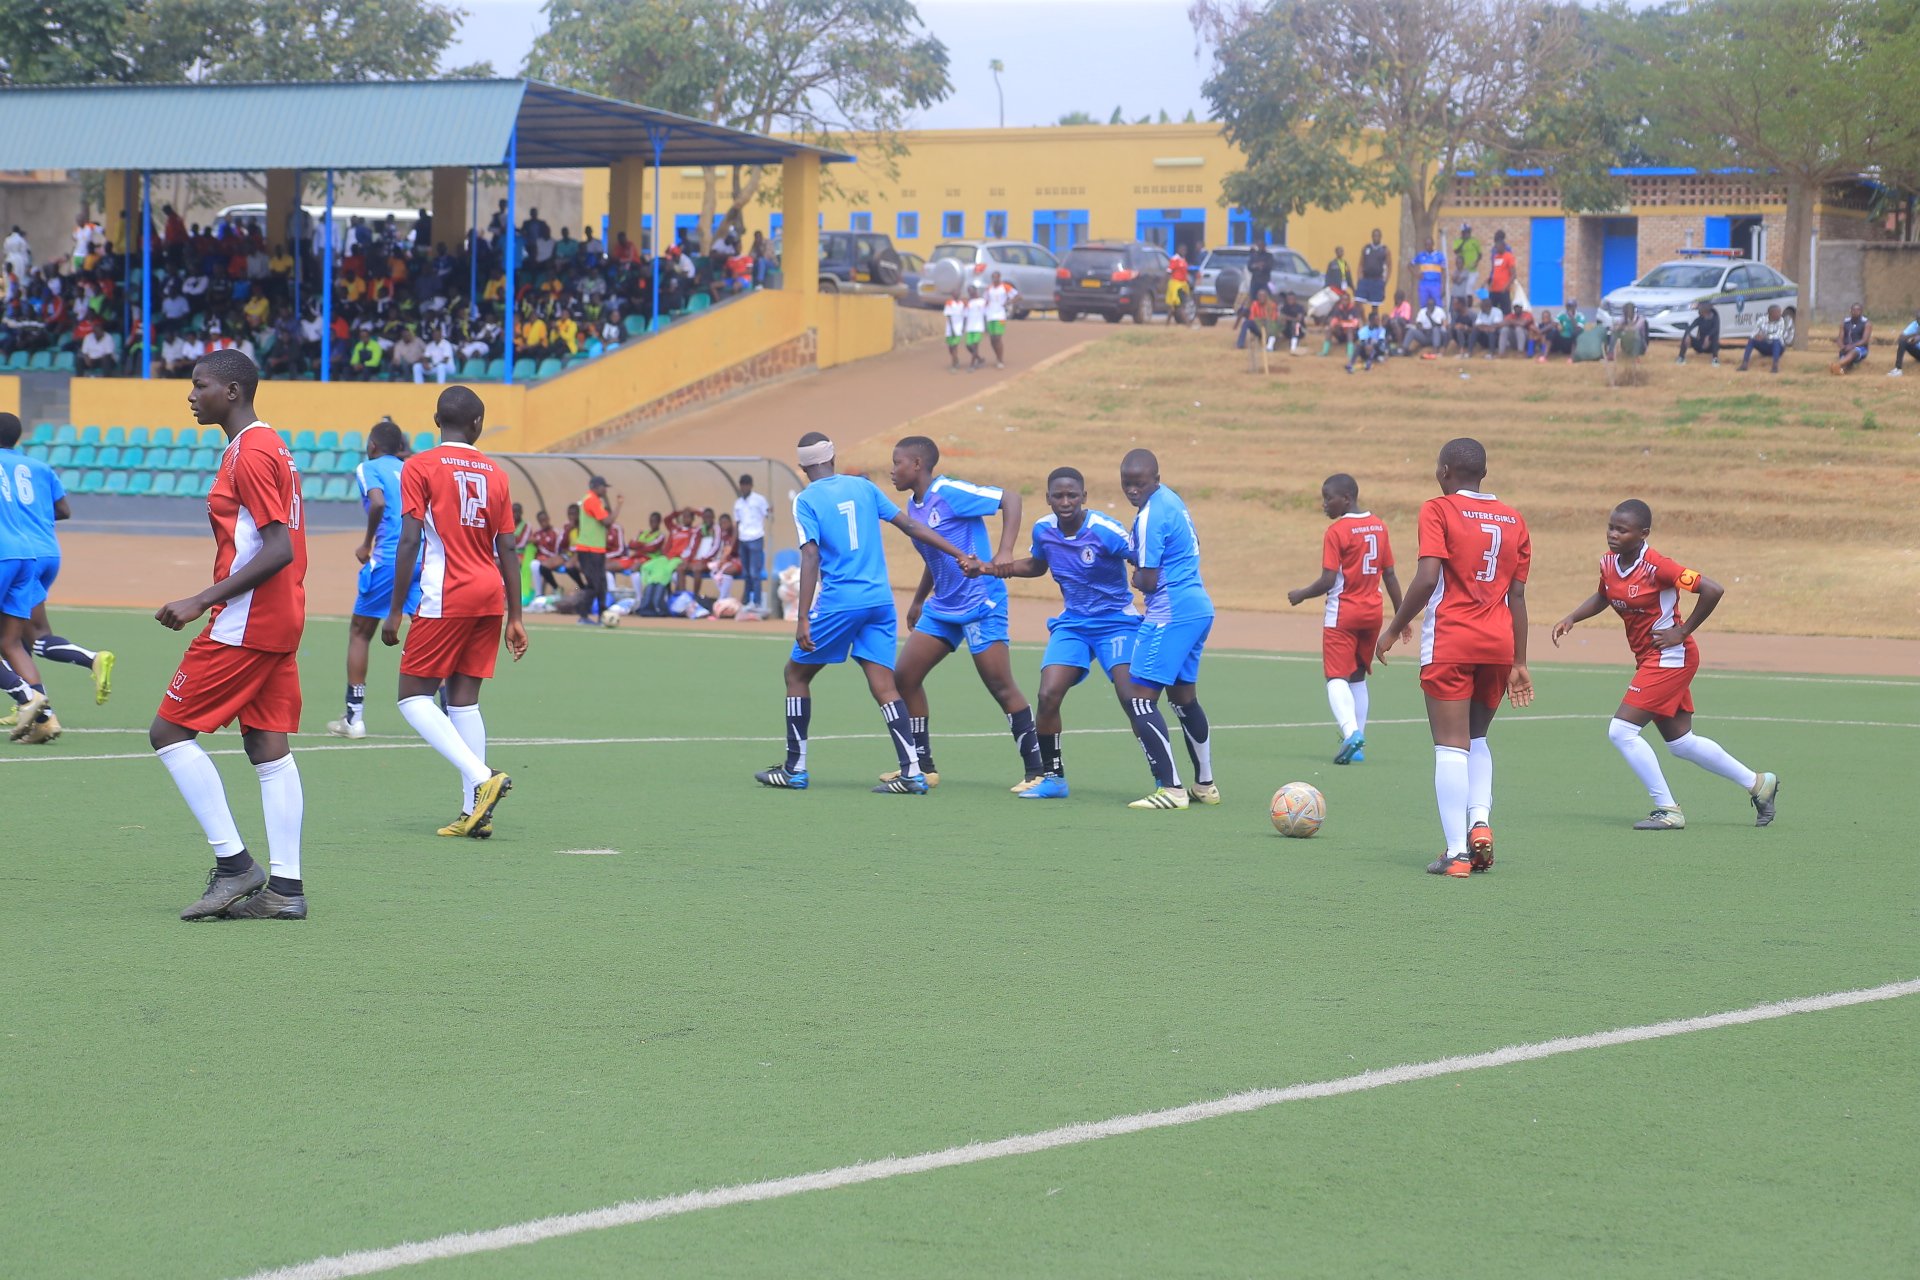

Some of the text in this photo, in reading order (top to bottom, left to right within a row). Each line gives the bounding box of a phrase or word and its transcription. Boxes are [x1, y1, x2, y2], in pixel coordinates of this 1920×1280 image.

[440, 457, 494, 472] BUTERE GIRLS
[452, 470, 487, 528] 12
[1462, 510, 1516, 524] BUTERE GIRLS
[1362, 534, 1378, 575] 2
[1475, 523, 1502, 582] 3
[1680, 574, 1694, 586] C
